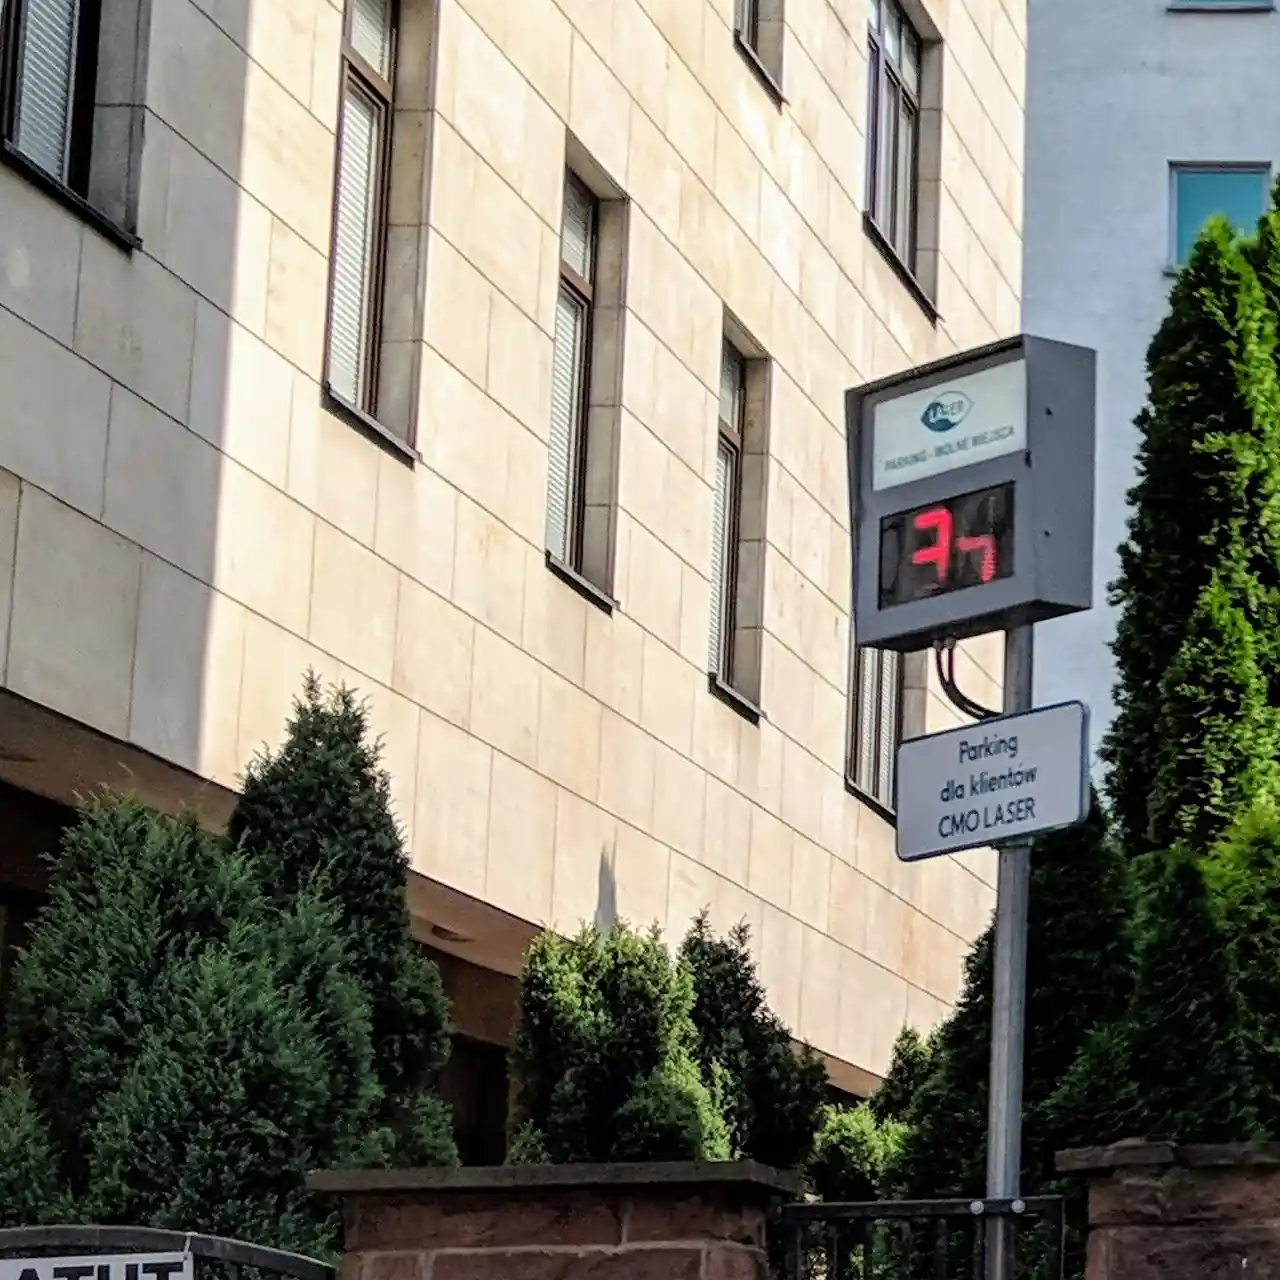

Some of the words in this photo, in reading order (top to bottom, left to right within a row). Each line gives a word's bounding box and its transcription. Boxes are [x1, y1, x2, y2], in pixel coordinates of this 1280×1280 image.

[959, 733, 1018, 764] Parking
[940, 780, 965, 802] dla
[970, 762, 1038, 796] klientów
[938, 809, 981, 839] CMO
[983, 797, 1036, 828] LASER
